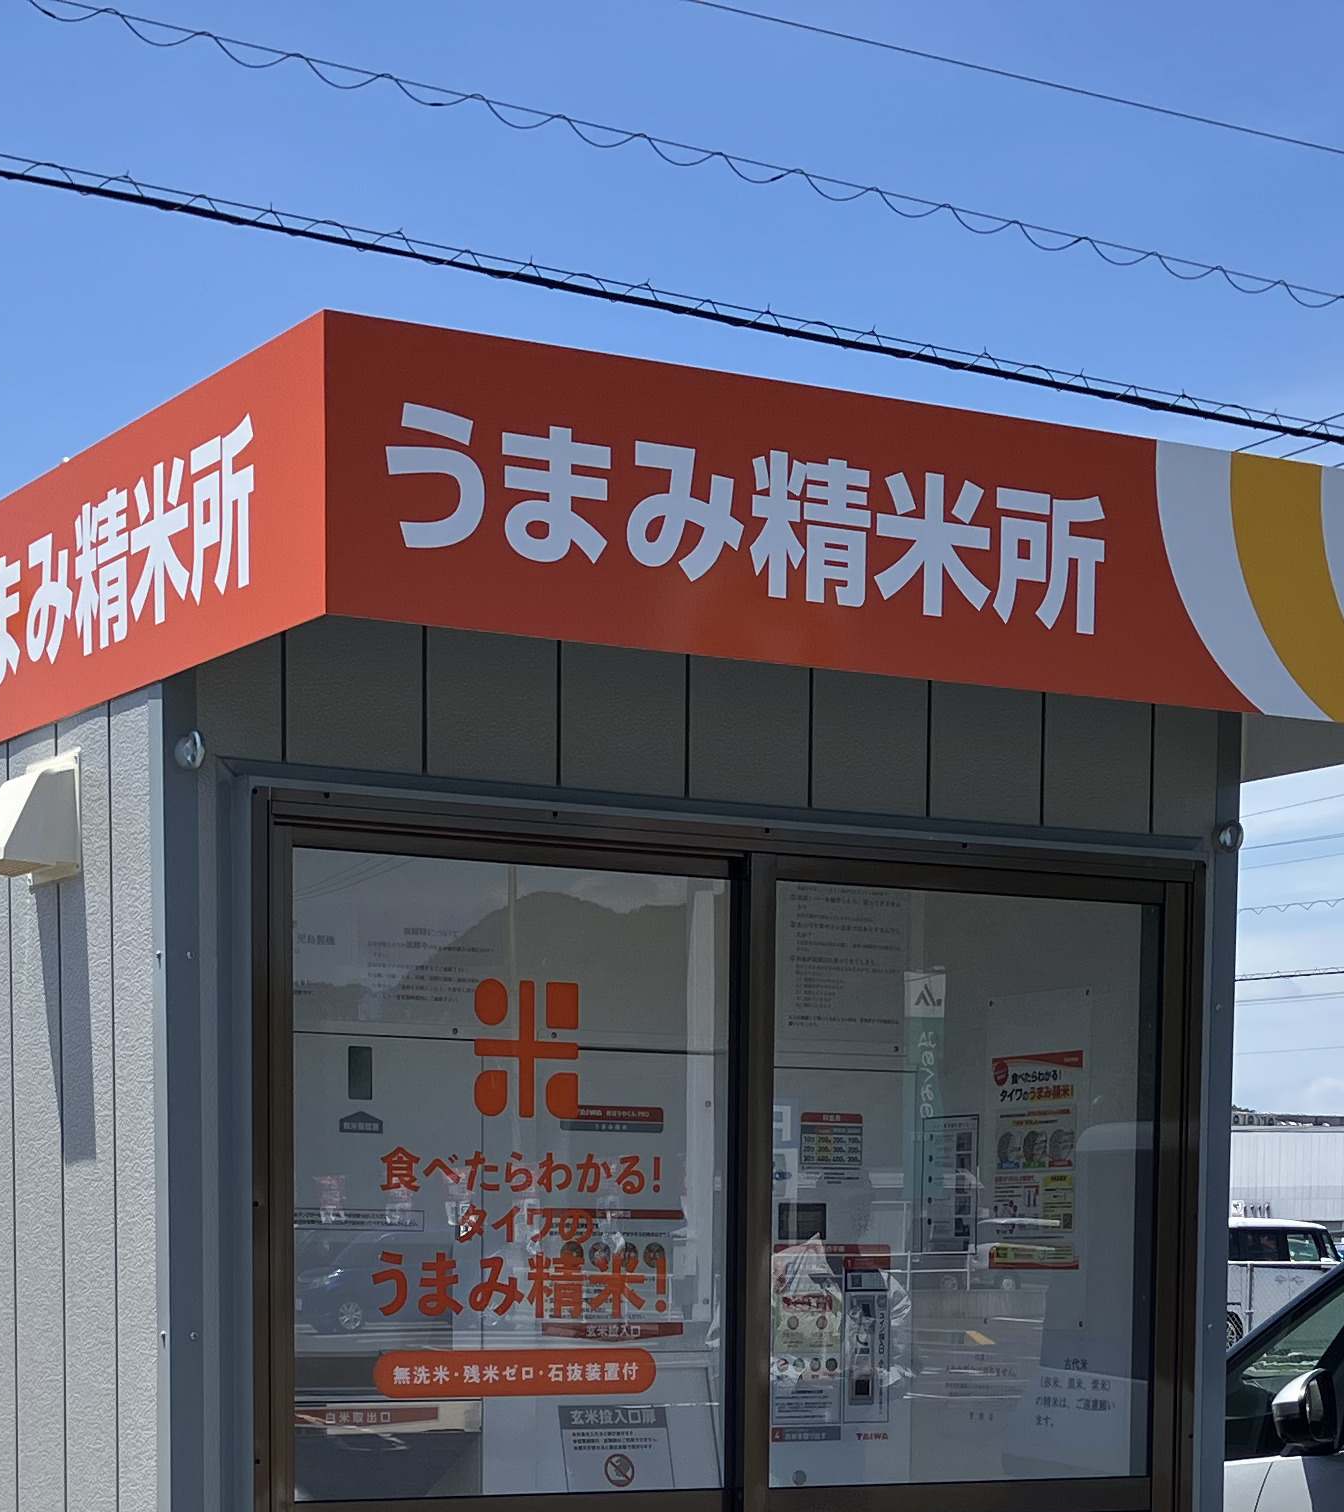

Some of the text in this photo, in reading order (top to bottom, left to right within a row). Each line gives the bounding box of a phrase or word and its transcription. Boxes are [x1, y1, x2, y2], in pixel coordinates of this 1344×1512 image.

[384, 401, 1108, 637] うまみ精米所
[379, 1145, 662, 1195] 食べたらわかる！
[455, 1202, 595, 1245] タイワの
[371, 1250, 669, 1320] うまみ精米！
[392, 1361, 639, 1387] 無洗米・残米ゼロ・石抜装置付
[856, 1432, 889, 1441] TAIWA
